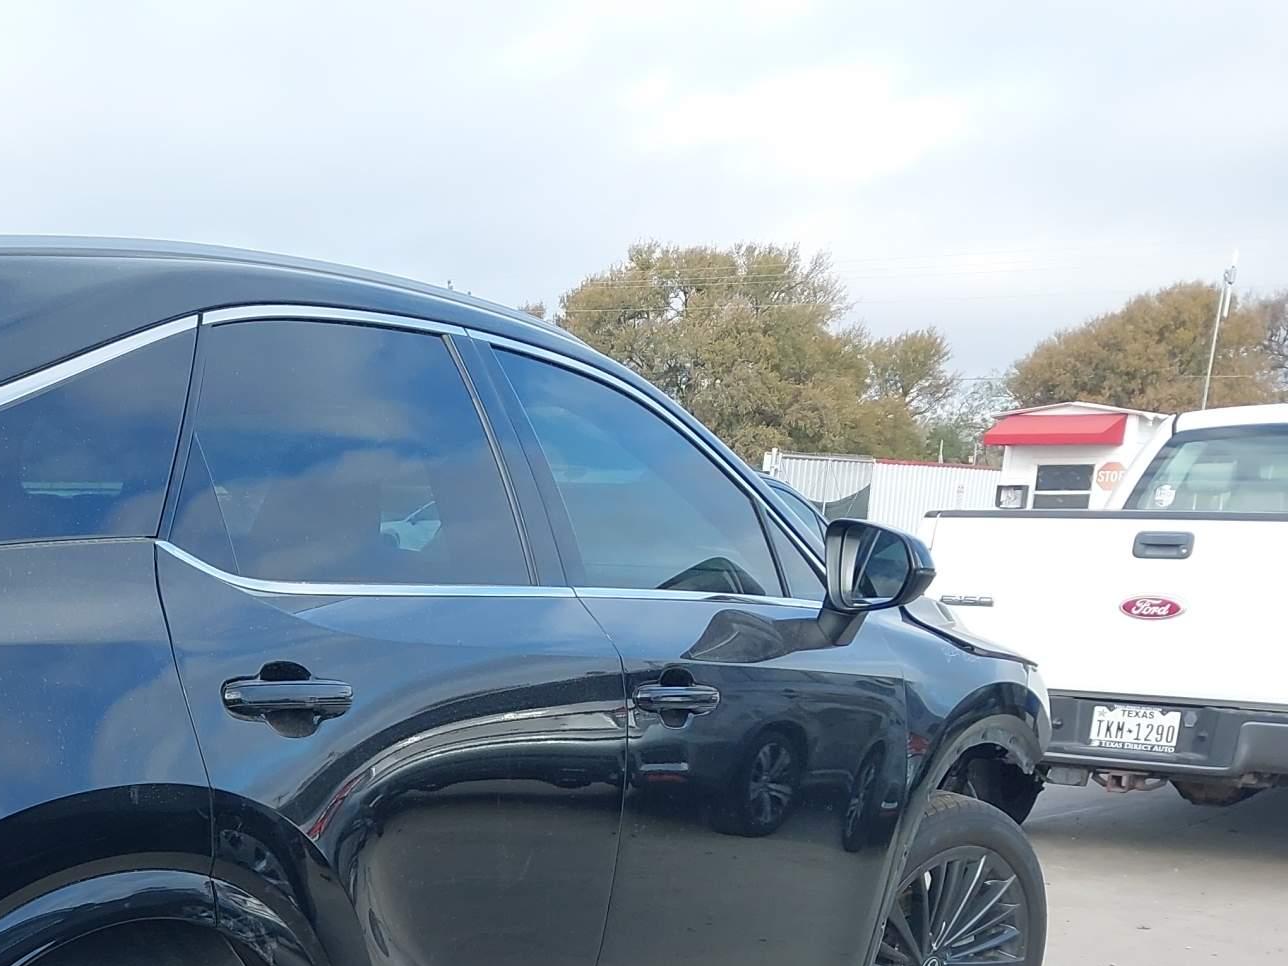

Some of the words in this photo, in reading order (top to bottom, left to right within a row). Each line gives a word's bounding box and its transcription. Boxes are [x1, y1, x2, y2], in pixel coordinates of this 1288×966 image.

[1131, 599, 1170, 616] Ford
[1121, 710, 1155, 719] TEXAS
[1101, 741, 1123, 749] TEXAS
[1152, 745, 1176, 753] AUTO
